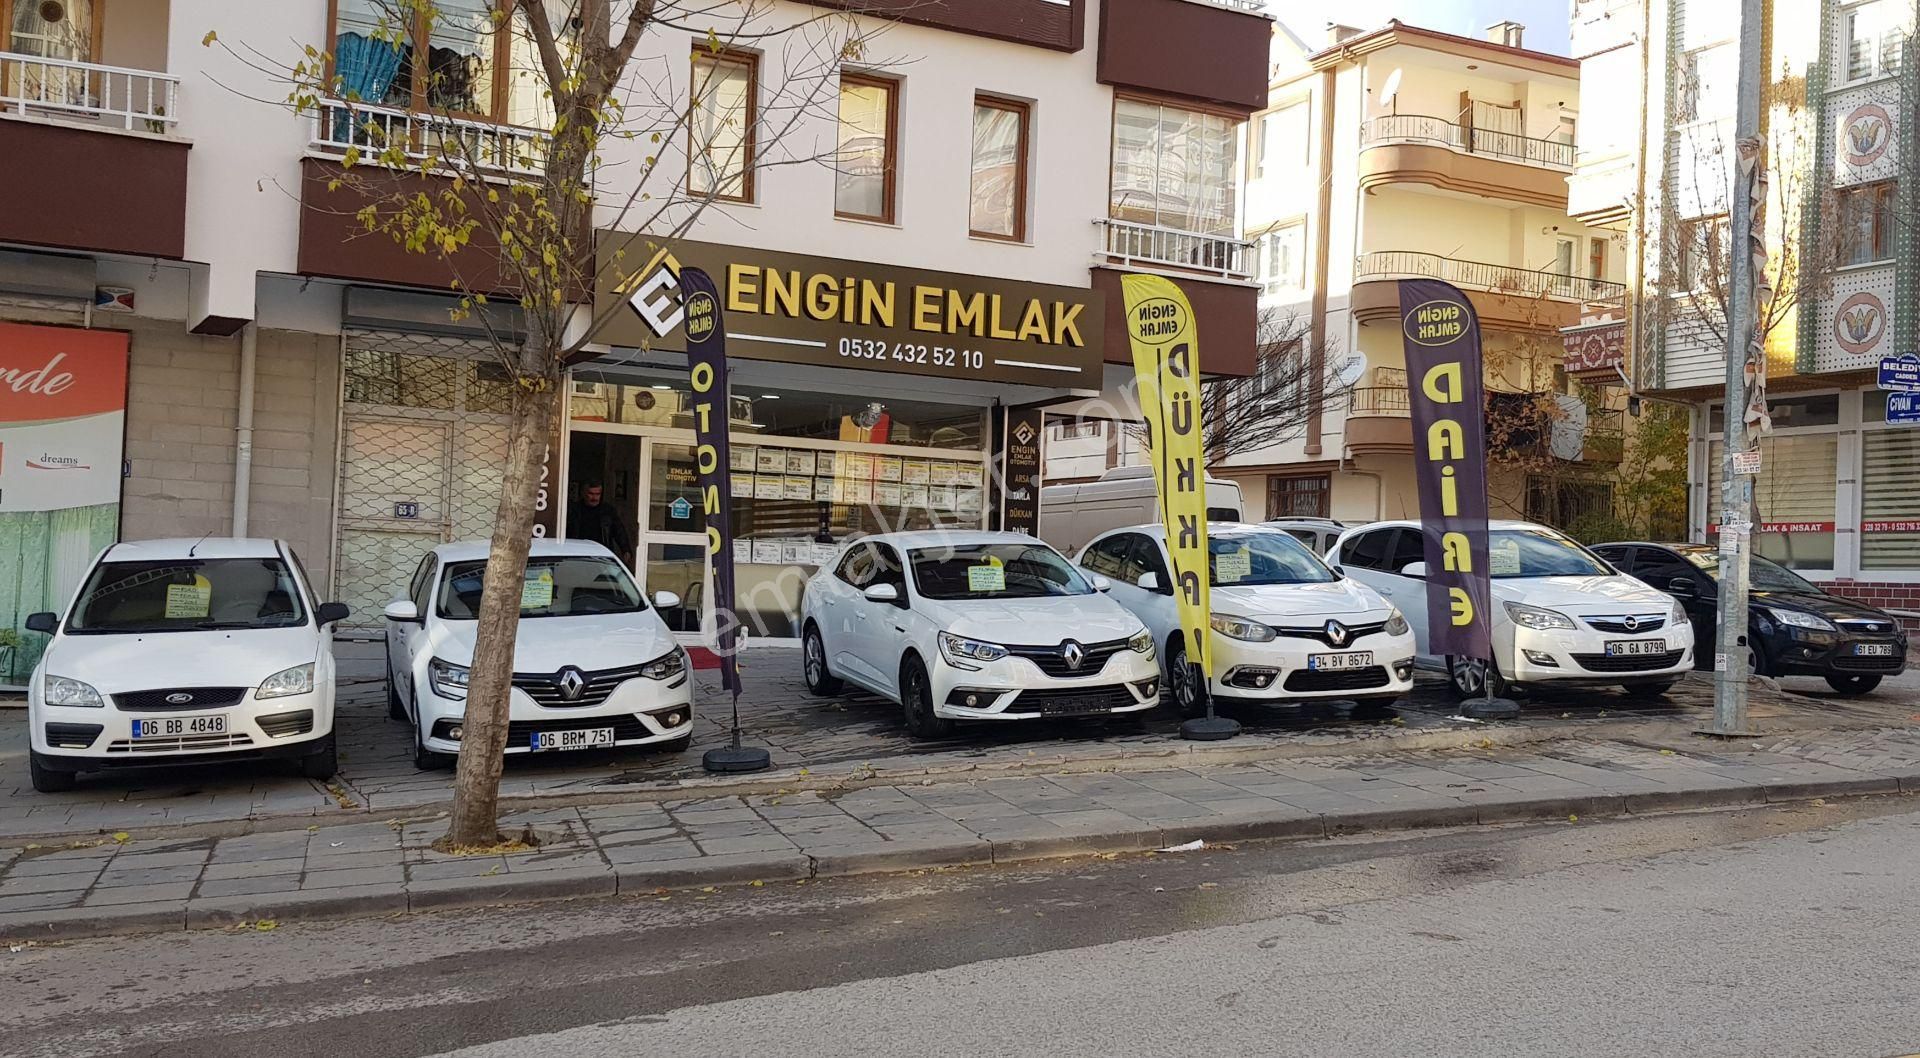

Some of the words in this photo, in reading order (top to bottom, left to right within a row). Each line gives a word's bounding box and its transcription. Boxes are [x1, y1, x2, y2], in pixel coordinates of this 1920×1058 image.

[913, 285, 1086, 348] EMLAK
[838, 337, 888, 361] 0532
[892, 343, 928, 365] 432
[932, 347, 956, 367] 52
[963, 350, 984, 370] 10
[40, 453, 79, 464] dreams
[670, 467, 693, 476] EMLAK
[1014, 474, 1030, 483] ARSA
[1012, 491, 1031, 501] TARLA
[1009, 507, 1033, 519] DÜKKAN
[1781, 524, 1788, 532] &
[1612, 643, 1624, 654] 06
[1629, 642, 1640, 654] GA
[1644, 641, 1664, 653] 8799
[1858, 645, 1866, 654] 61
[1867, 645, 1877, 655] EU
[1315, 656, 1327, 668] 34
[1332, 655, 1343, 667] BV
[1348, 653, 1371, 666] 8672
[141, 720, 158, 735] 06
[166, 719, 183, 734] BB
[190, 717, 223, 732] 4848
[540, 733, 555, 747] 06
[562, 730, 586, 745] BRM
[592, 729, 612, 743] 751
